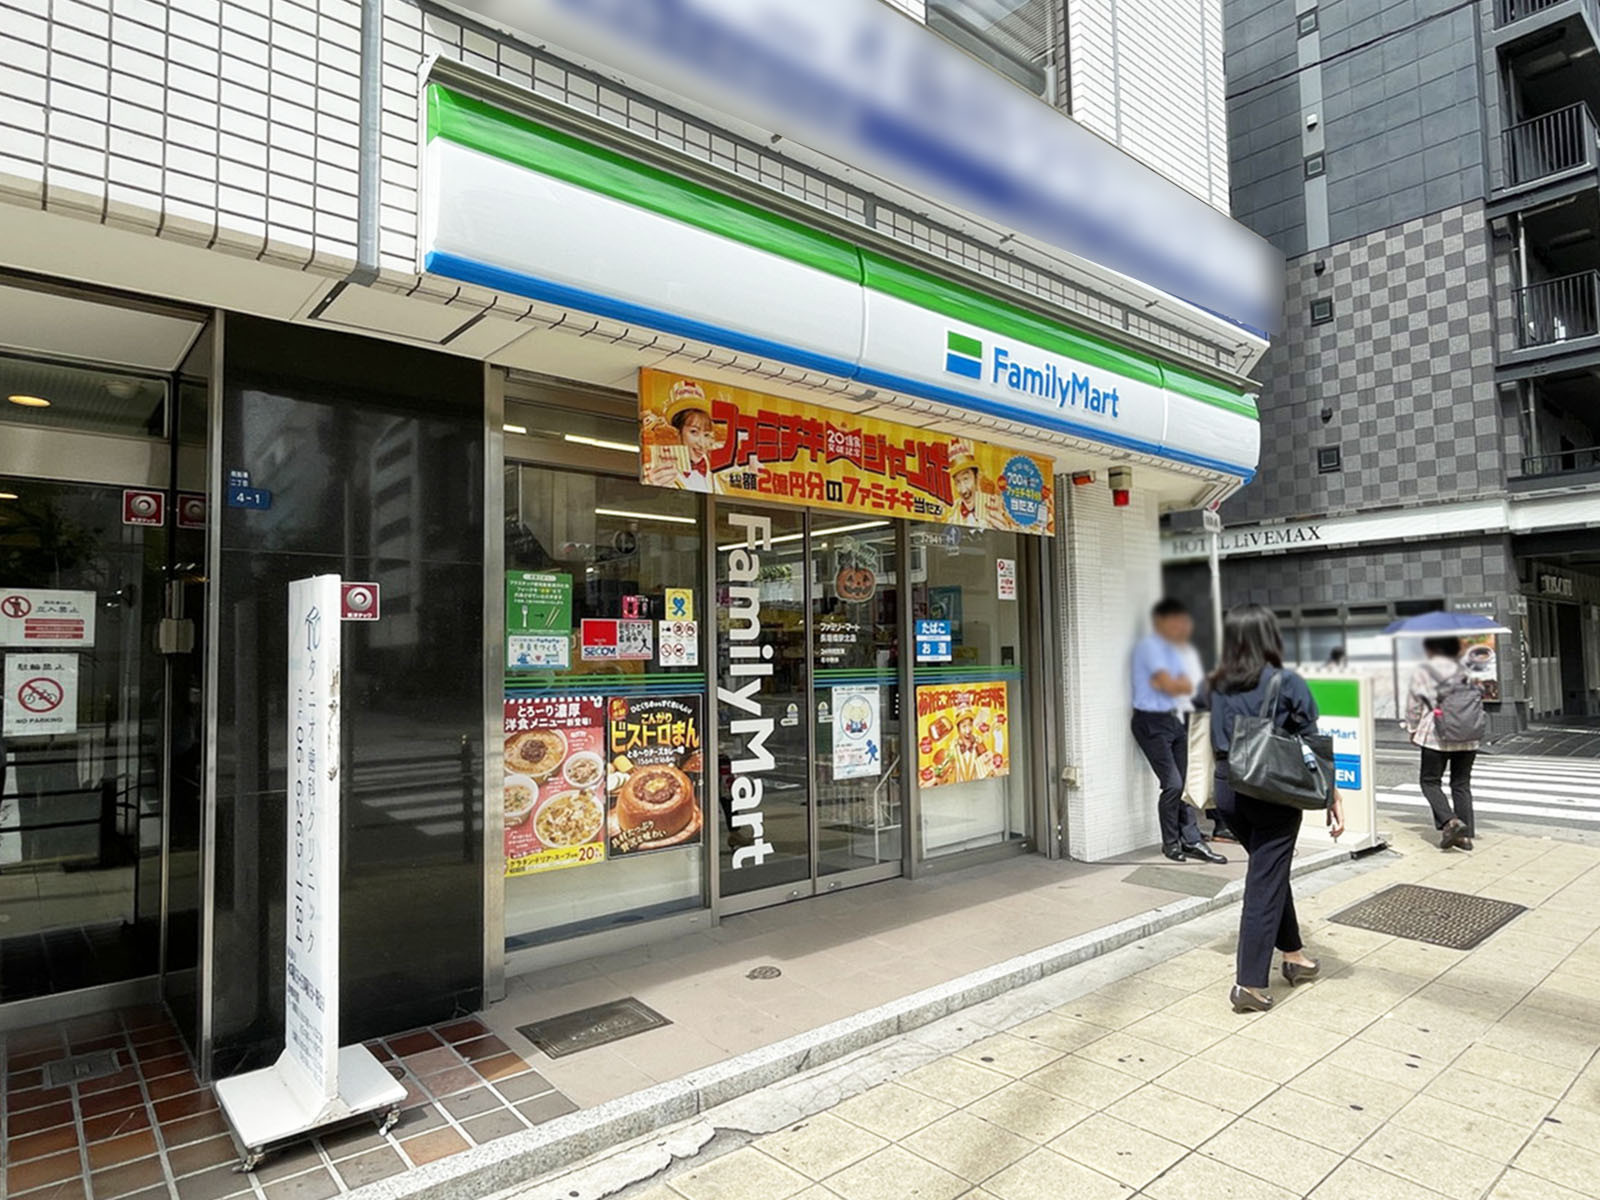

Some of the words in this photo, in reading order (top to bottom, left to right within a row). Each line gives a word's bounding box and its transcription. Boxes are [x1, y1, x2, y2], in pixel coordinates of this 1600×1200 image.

[992, 347, 1120, 418] FamilyMart
[711, 399, 825, 473] ファミチキ
[862, 434, 954, 507] ジャンボ
[236, 492, 260, 504] 4-1
[1172, 538, 1230, 555] HOTL
[1234, 525, 1321, 548] LiVEMAX
[921, 622, 946, 635] たばこ
[584, 646, 617, 656] SECOM
[717, 513, 777, 869] FamilyMart
[517, 703, 581, 718] とろーり濃厚
[641, 711, 673, 725] こんがり
[610, 717, 700, 753] ビストロまん
[1335, 769, 1356, 783] EN
